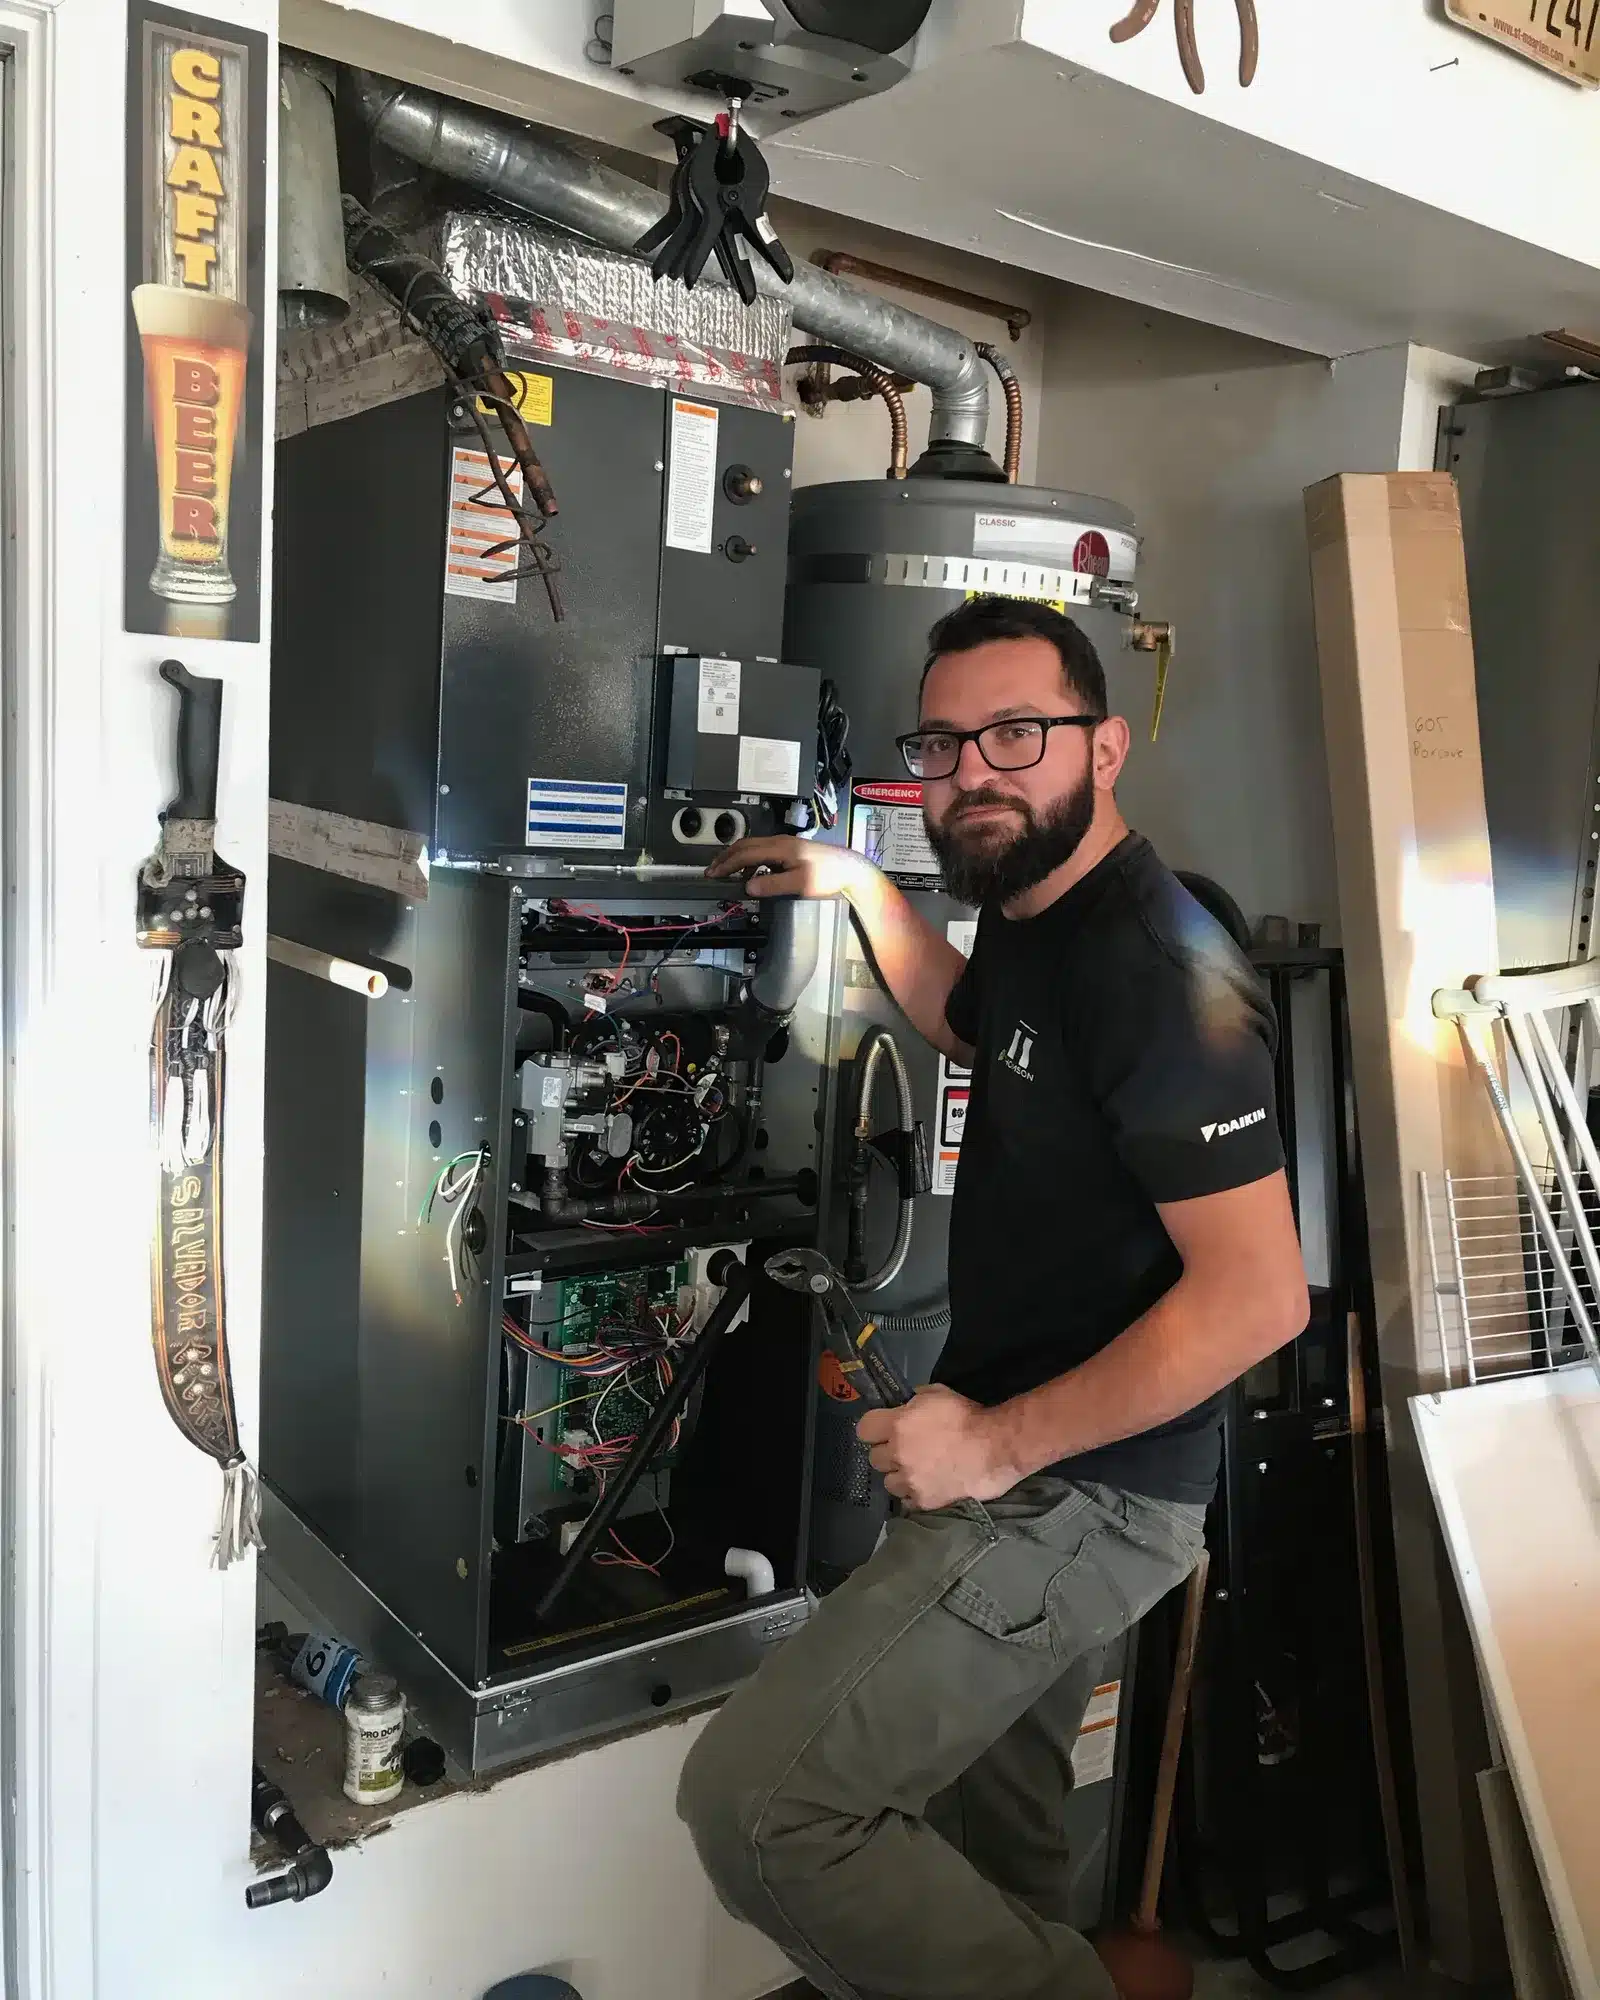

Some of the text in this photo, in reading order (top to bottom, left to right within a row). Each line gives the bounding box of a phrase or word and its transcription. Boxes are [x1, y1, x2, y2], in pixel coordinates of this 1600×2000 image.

[167, 49, 226, 287] CRAFT
[172, 355, 219, 543] BEER
[979, 517, 1016, 528] CLASSIC
[860, 787, 922, 798] EMERGENCY
[1218, 1107, 1267, 1136] DAIKIN
[170, 1175, 207, 1334] SALVADOR
[361, 1730, 379, 1740] PRO
